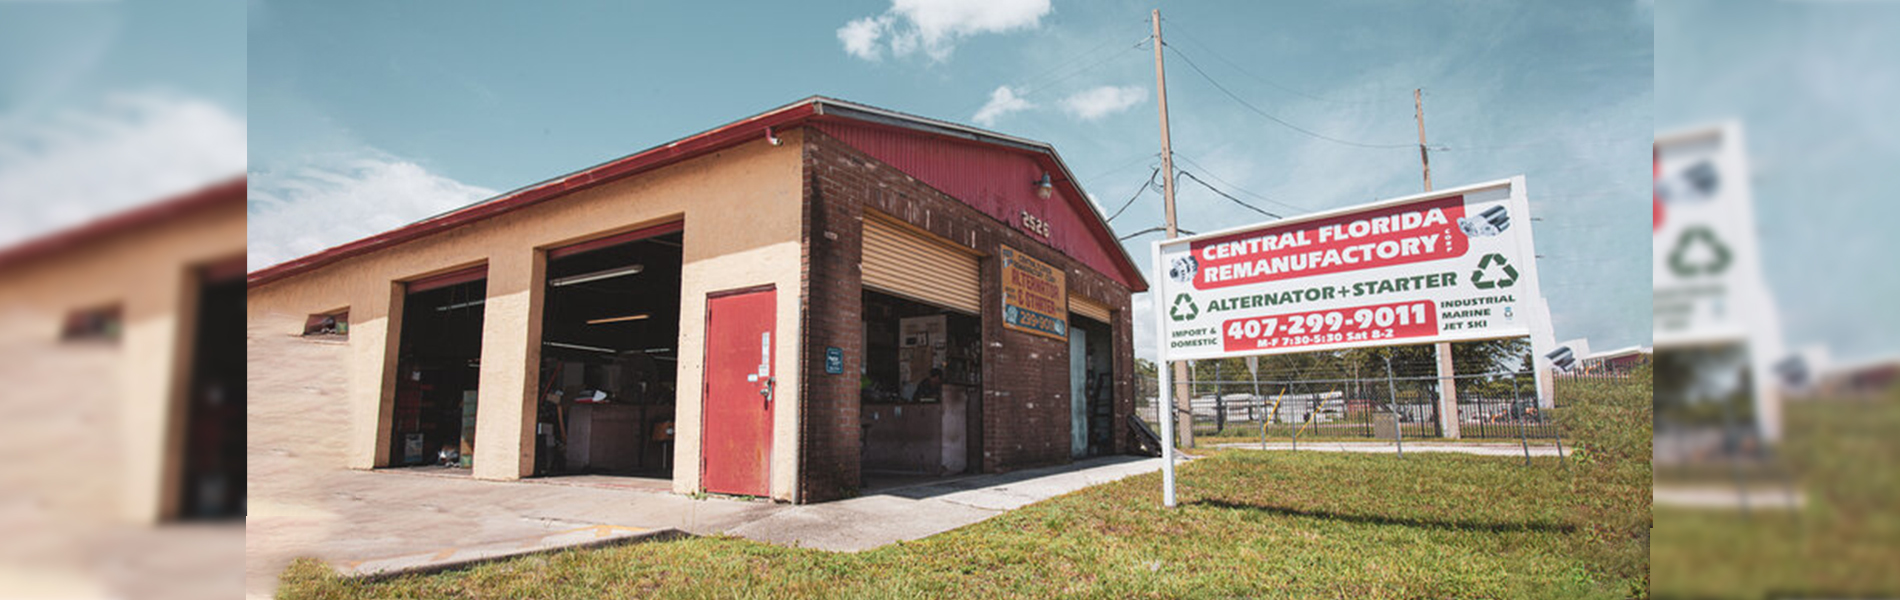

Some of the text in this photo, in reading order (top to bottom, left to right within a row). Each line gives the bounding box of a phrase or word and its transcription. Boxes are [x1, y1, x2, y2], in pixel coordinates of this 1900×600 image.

[1021, 210, 1050, 238] 2526
[1203, 208, 1448, 260] CENTRAL FLORIDA
[1204, 234, 1440, 283] REMANUFACTORY
[1441, 295, 1516, 308] INDUSTRIAL
[1227, 303, 1426, 340] 407-299-9011
[1442, 308, 1491, 319] MARINE
[1172, 327, 1217, 338] IMPORT &
[1443, 320, 1487, 331] JET SKI
[1171, 338, 1217, 348] DOMESTIC
[1257, 328, 1394, 348] M-F 7:30-5:30 Sat 8-2
